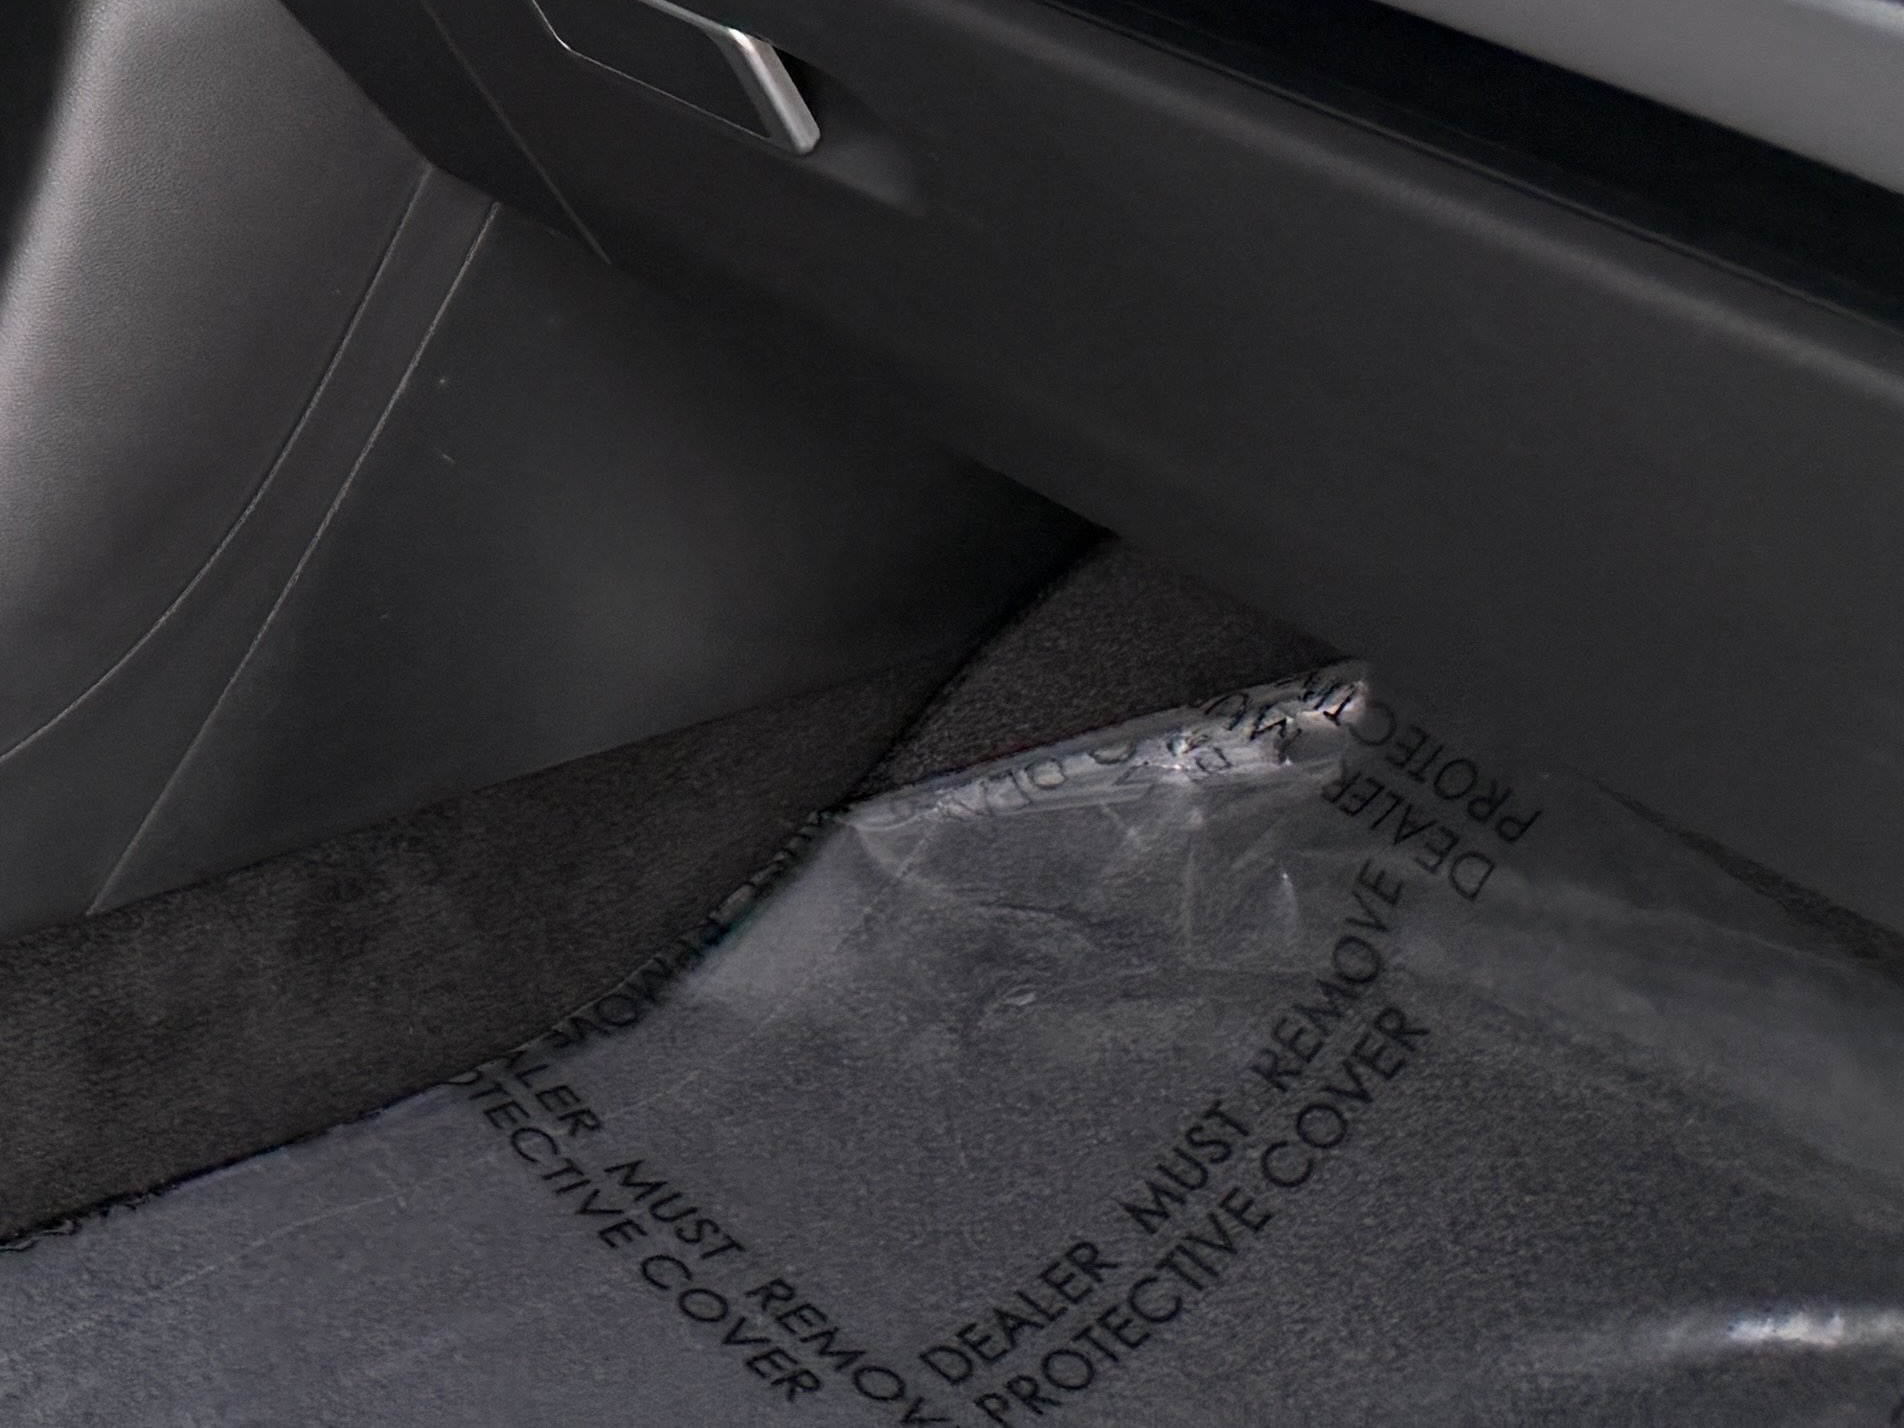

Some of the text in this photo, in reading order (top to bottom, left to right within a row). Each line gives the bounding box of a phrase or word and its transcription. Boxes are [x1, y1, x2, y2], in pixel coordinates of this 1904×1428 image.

[604, 1159, 746, 1261] MUST
[744, 1277, 954, 1428] REMOV
[918, 860, 1402, 1386] DEALER MUST REMOVE
[974, 1004, 1432, 1428] PROTECTIVE COVER
[640, 1253, 822, 1402] COVER
